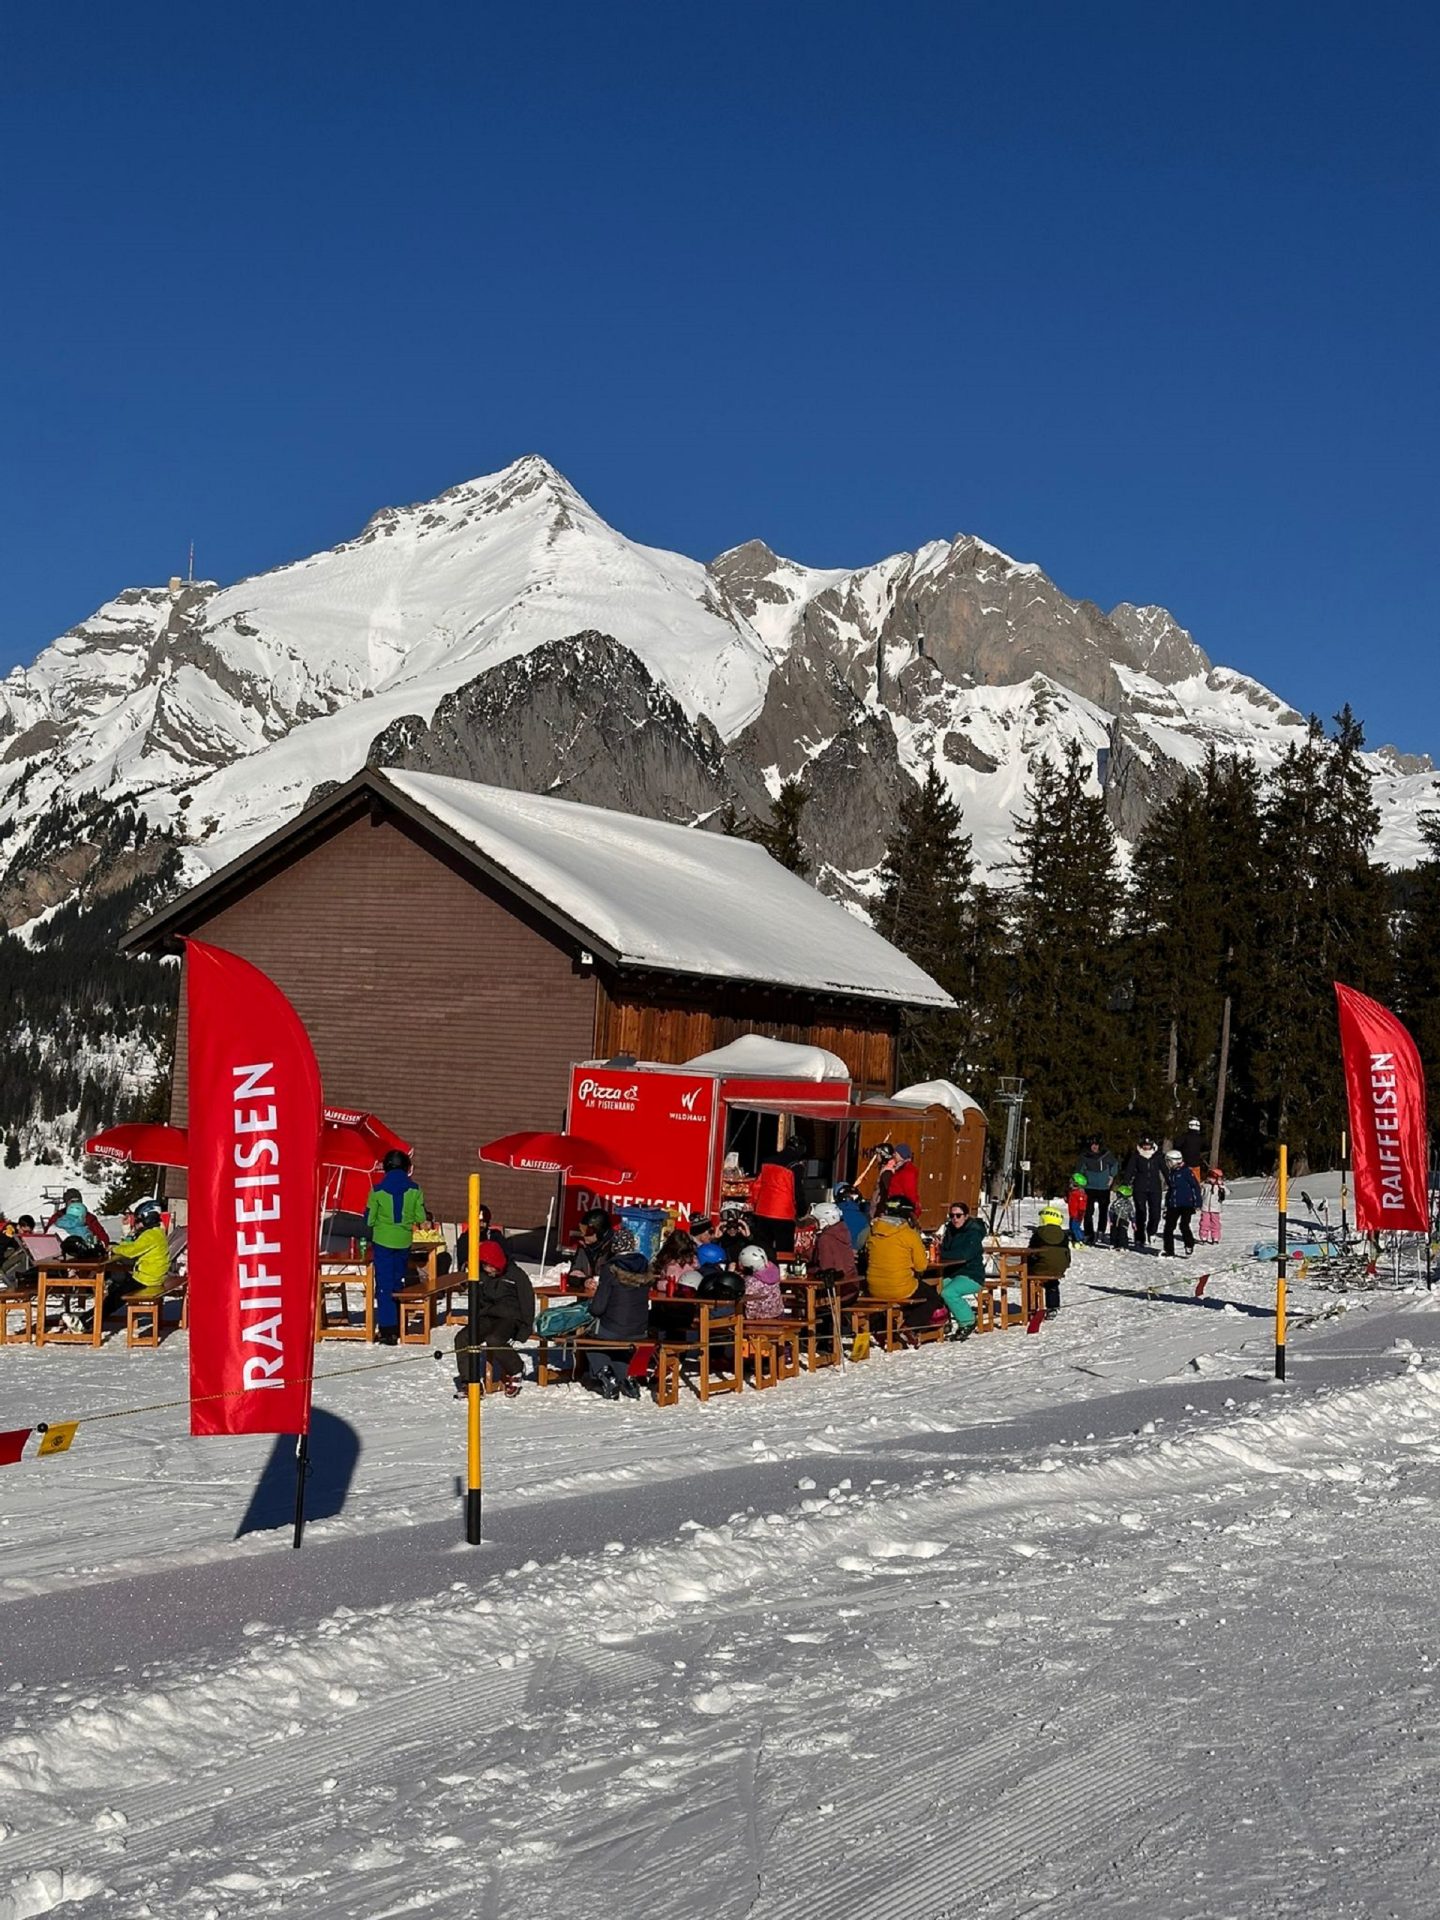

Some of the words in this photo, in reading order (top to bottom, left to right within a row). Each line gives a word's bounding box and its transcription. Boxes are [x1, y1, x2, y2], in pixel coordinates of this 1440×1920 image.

[578, 1079, 622, 1100] Pizza
[585, 1099, 595, 1108] AM
[598, 1100, 635, 1112] PISTENRAND
[669, 1112, 706, 1122] WILDHAUS
[1369, 1052, 1404, 1210] RAIFFEISEN
[233, 1062, 286, 1389] RAIFFEISEN
